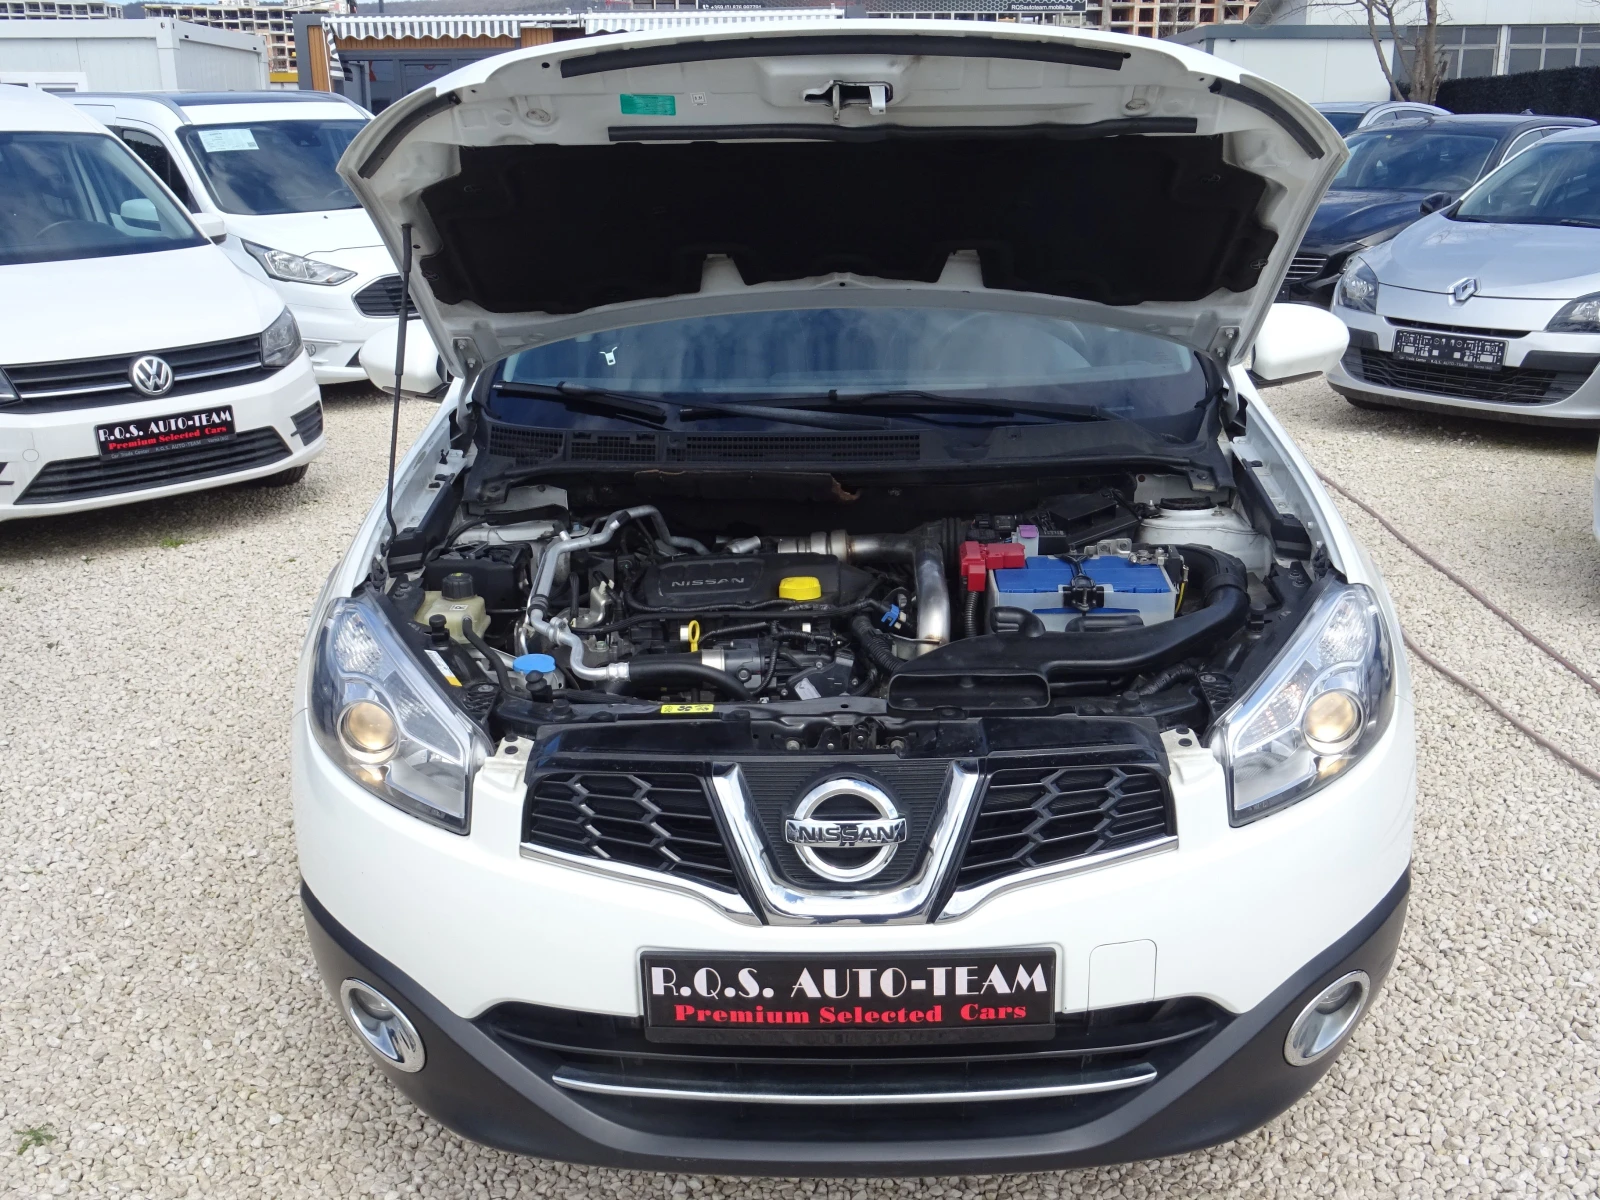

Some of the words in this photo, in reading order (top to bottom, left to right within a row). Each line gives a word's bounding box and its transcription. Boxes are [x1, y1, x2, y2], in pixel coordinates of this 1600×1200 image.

[98, 424, 144, 441] R.Q.S.
[148, 410, 232, 434] AUTO-TEAM
[108, 437, 157, 450] Premium
[159, 429, 200, 442] Selected
[204, 426, 227, 436] Cars
[671, 577, 745, 587] NISSAN
[799, 825, 894, 842] NISSAN
[651, 966, 775, 1000] R.Q.S.
[790, 963, 1048, 999] AUTO-TEAM
[674, 1004, 810, 1024] Premium
[819, 1004, 943, 1024] Selected
[960, 1003, 1027, 1021] Cars
